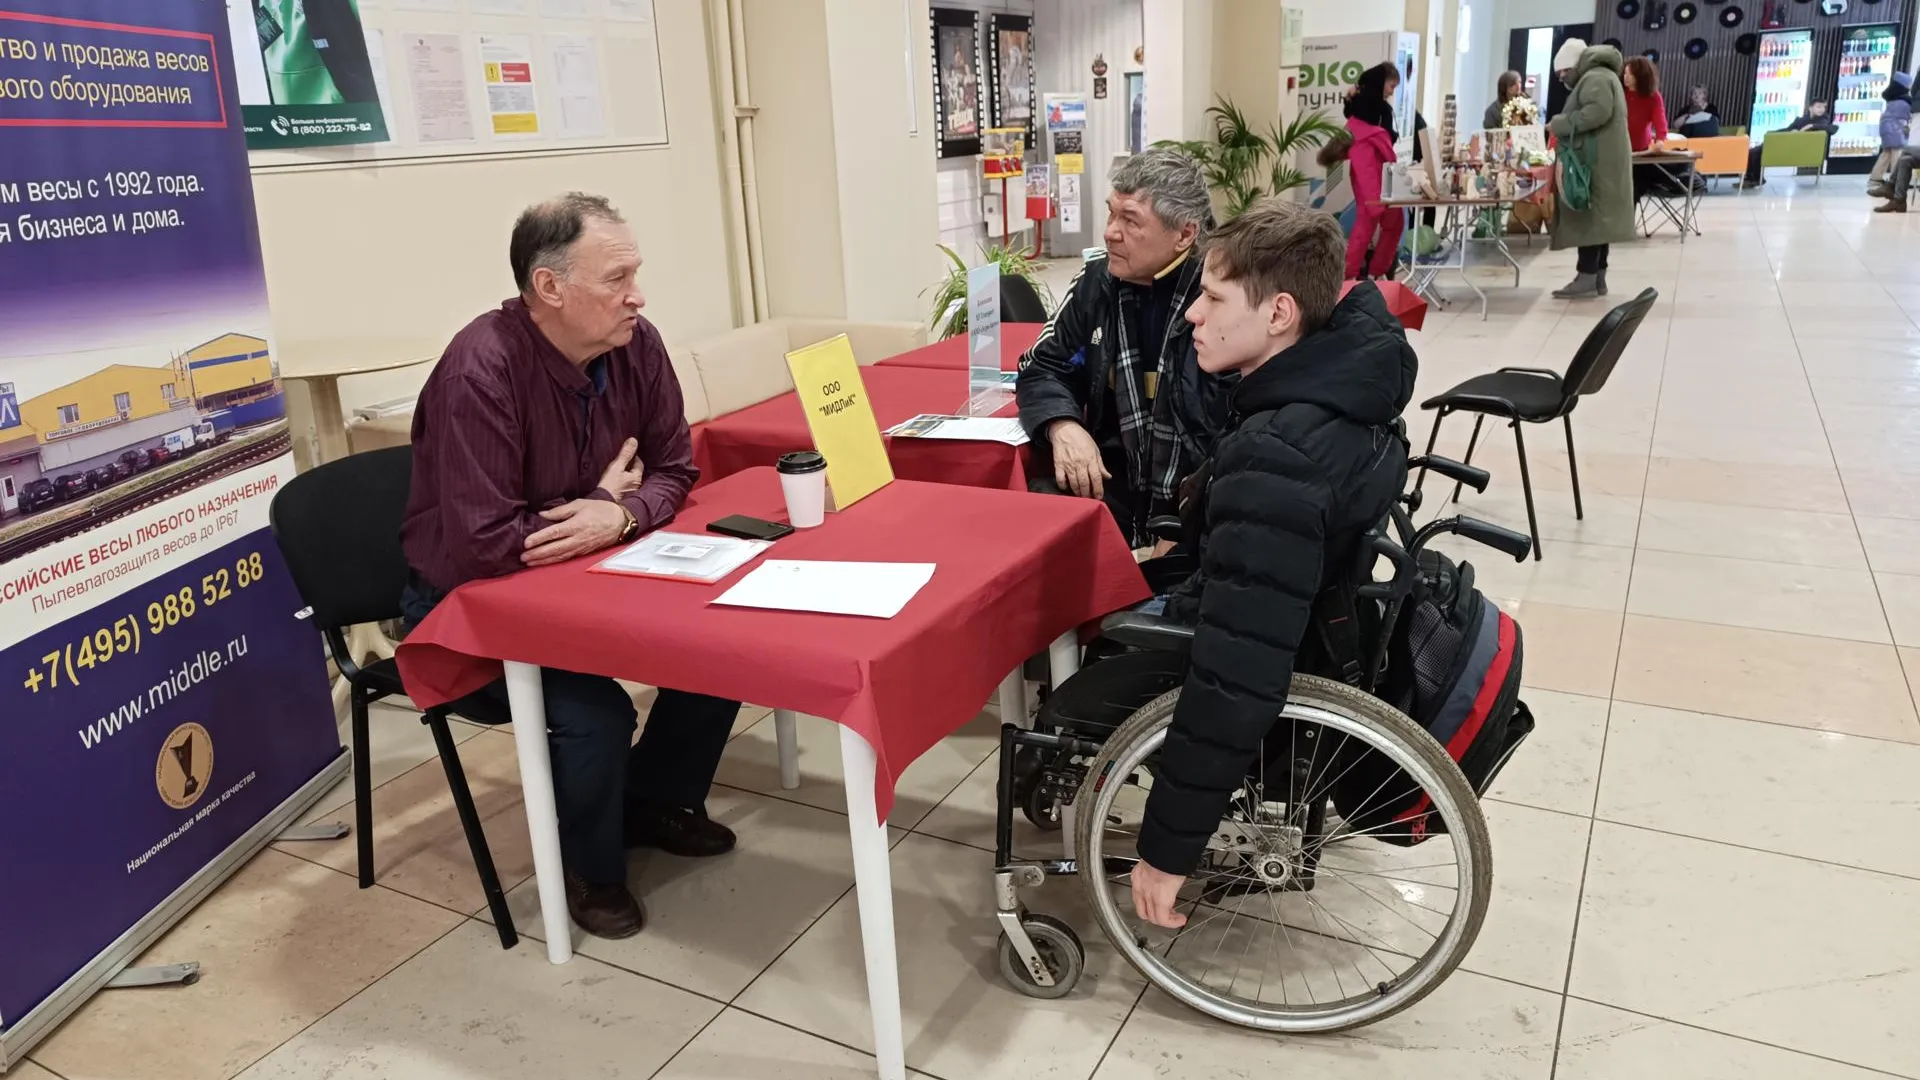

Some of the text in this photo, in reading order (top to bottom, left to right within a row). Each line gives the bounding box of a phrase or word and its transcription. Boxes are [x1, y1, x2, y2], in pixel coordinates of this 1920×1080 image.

[43, 41, 56, 61] и
[62, 42, 151, 71] продажа
[155, 50, 209, 73] весов
[50, 75, 192, 107] оборудования
[300, 126, 325, 135] (800)
[27, 177, 83, 202] весы
[87, 178, 99, 198] с
[104, 171, 152, 197] 1992
[157, 174, 205, 196] года.
[18, 212, 107, 241] бизнеса
[113, 214, 126, 232] и
[132, 208, 185, 234] дома.
[822, 380, 841, 396] ООО
[88, 533, 133, 566] ВЕСЫ
[136, 508, 195, 546] ЛЮБОГО
[197, 474, 278, 519] НАЗНАЧЕНИЯ
[32, 510, 239, 613] Пылевлагозащита весов до IP67
[24, 552, 263, 693] +7(495) 988 52 88
[78, 634, 248, 750] www.middle.ru
[126, 771, 256, 874] Национальная марка качества
